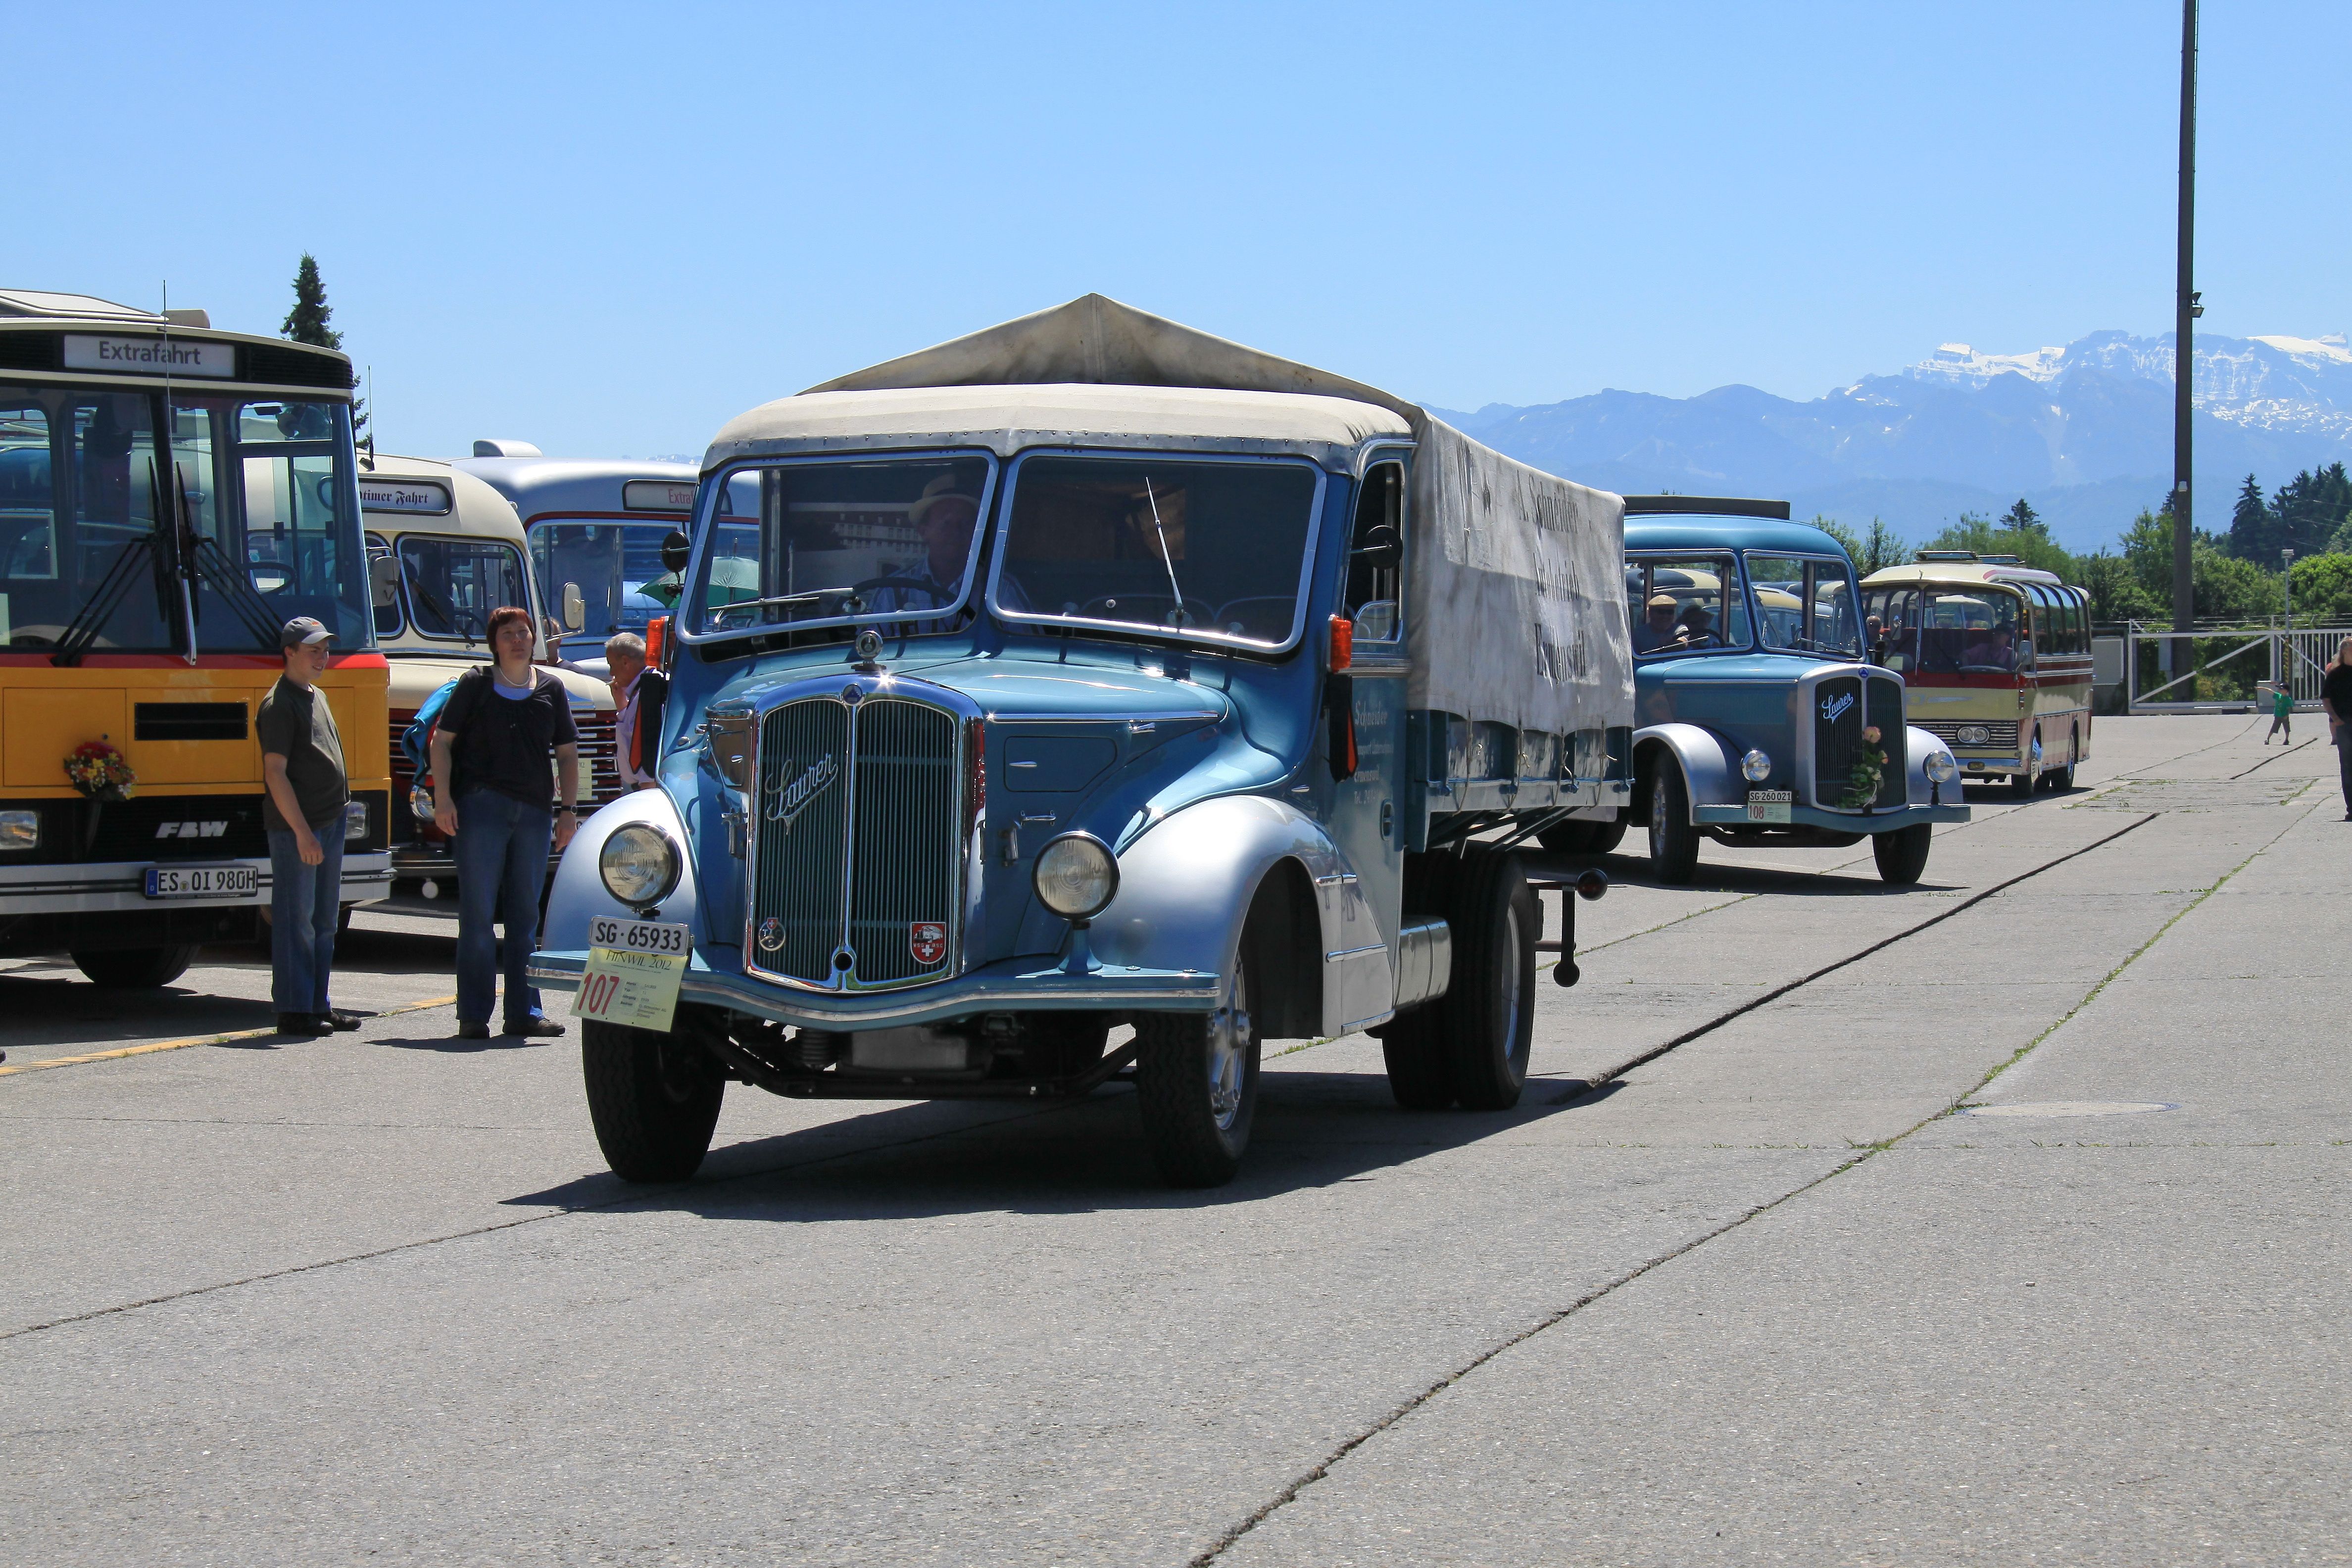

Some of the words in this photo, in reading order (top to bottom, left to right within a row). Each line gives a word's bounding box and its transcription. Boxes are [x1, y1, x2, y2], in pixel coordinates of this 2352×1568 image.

[99, 341, 201, 365] Extrafahrt
[395, 490, 428, 506] Fahrt
[1821, 692, 1854, 724] Saurer
[765, 753, 838, 835] Saurer
[1750, 805, 1764, 820] 108
[155, 821, 228, 838] FBW
[158, 873, 179, 891] ES
[649, 957, 672, 970] 2012
[578, 972, 619, 1015] 107
